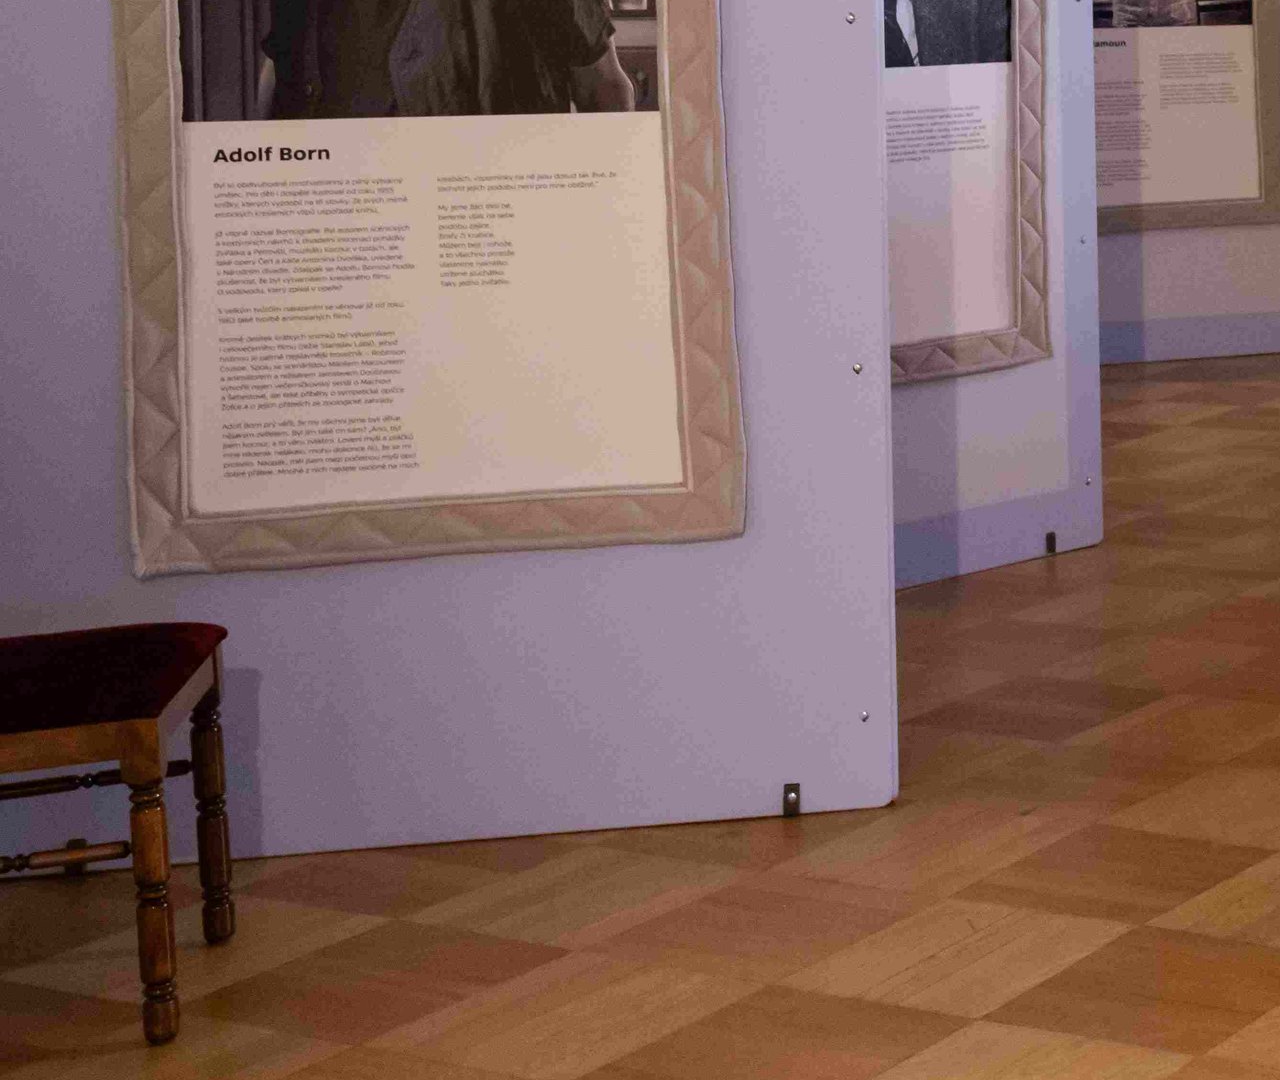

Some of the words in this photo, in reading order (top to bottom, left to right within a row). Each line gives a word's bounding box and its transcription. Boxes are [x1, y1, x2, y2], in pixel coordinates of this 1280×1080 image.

[1093, 40, 1127, 48] amoun
[213, 146, 273, 163] Adolf
[279, 147, 331, 161] Born
